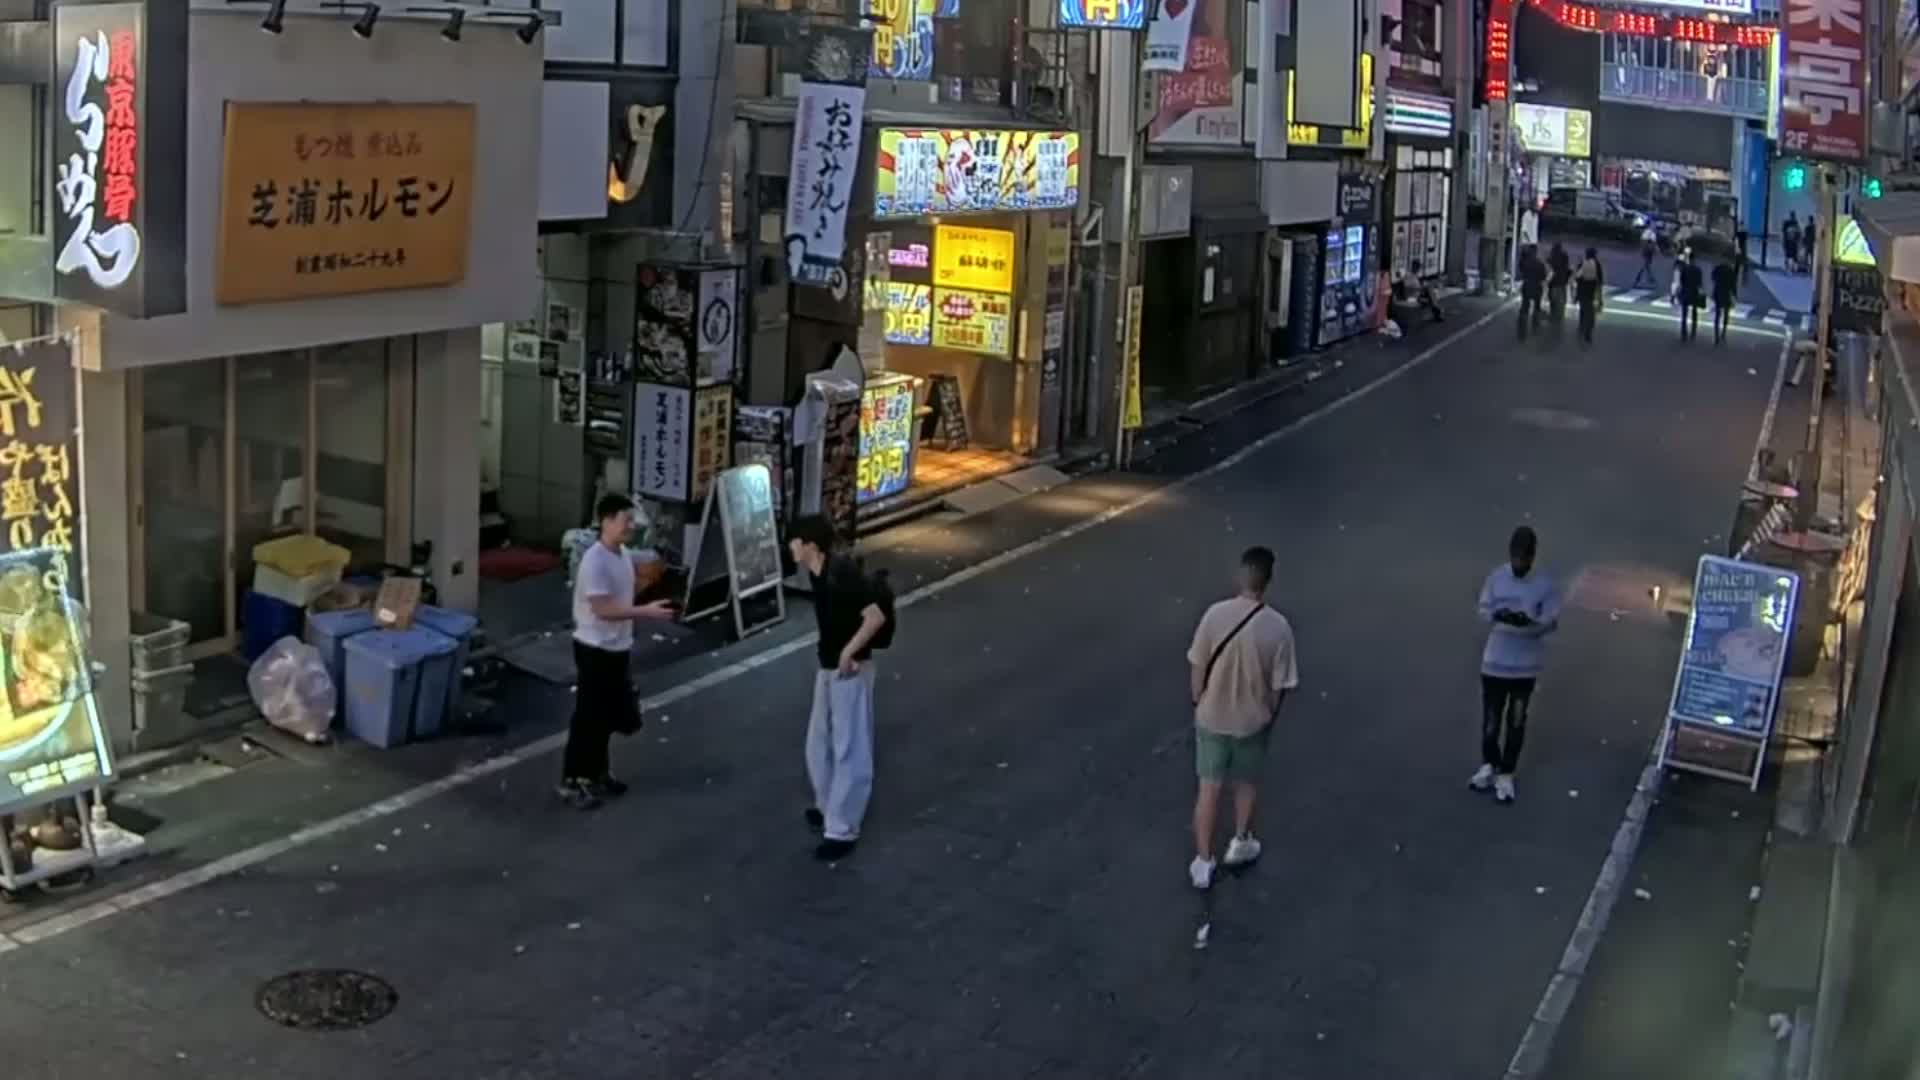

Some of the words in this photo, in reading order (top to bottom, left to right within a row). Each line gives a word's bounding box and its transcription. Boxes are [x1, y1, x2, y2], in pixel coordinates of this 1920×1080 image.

[103, 29, 137, 222] 東京豚骨
[1785, 129, 1808, 149] 2F
[248, 175, 455, 229] 芝浦ホルモン
